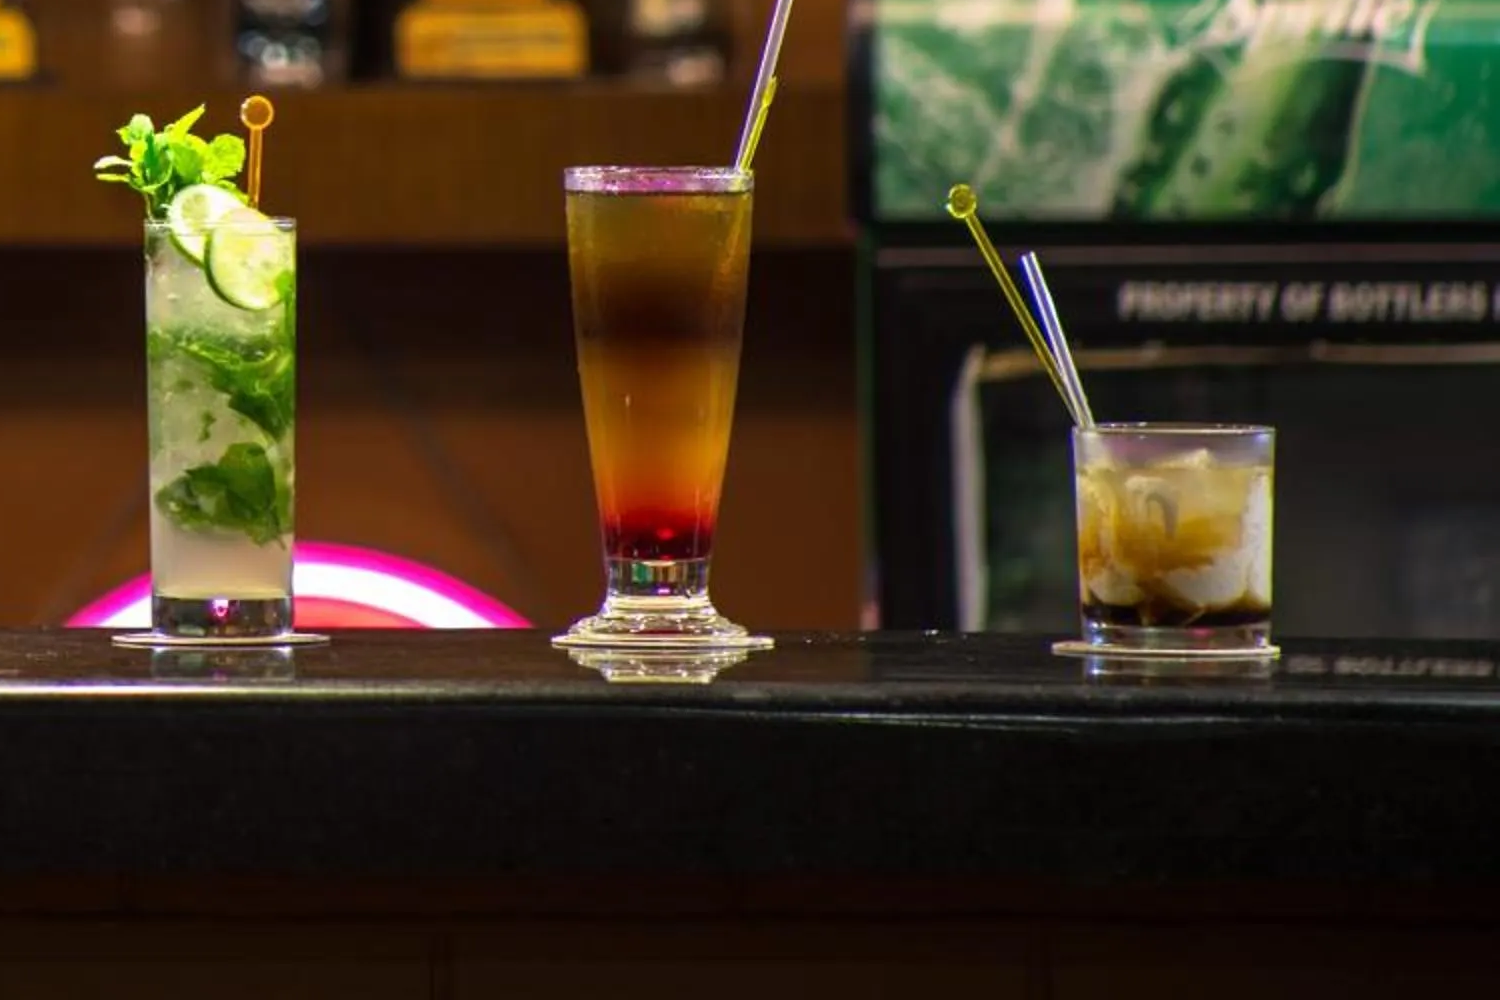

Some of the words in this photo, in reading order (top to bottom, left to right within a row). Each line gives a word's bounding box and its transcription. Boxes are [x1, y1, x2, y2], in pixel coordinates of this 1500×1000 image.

[1118, 280, 1277, 322] PROPERTY
[1280, 280, 1322, 322] OF
[1328, 280, 1488, 322] BOTTLERS
